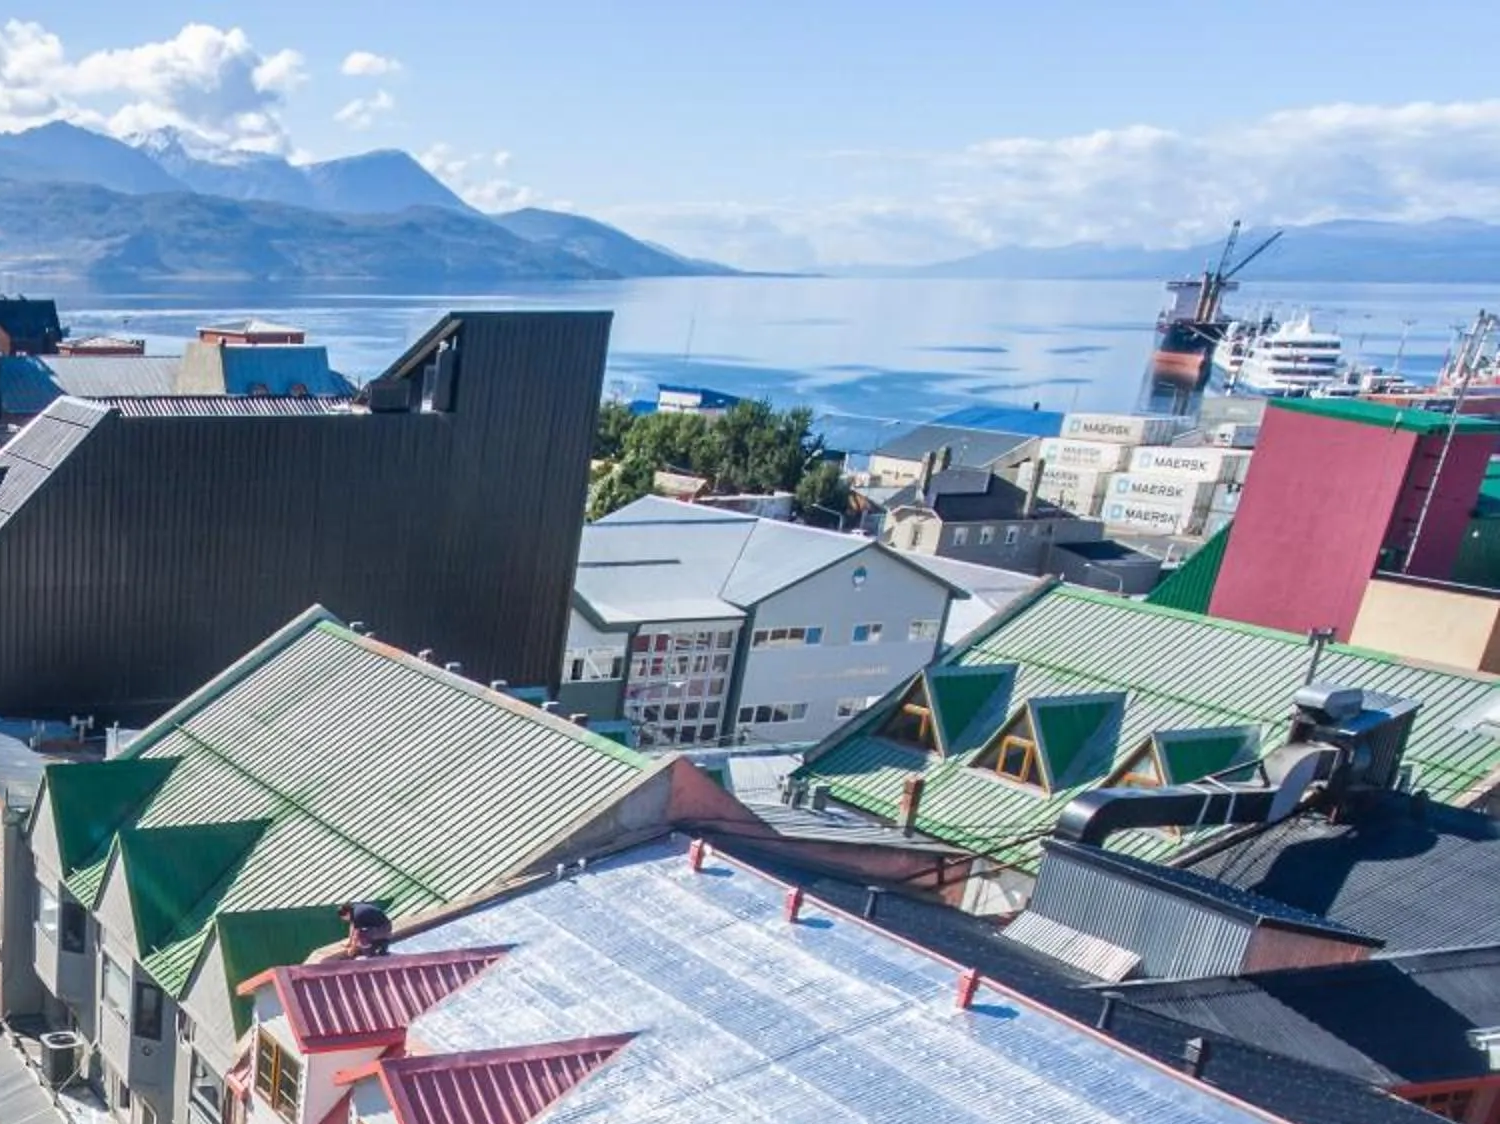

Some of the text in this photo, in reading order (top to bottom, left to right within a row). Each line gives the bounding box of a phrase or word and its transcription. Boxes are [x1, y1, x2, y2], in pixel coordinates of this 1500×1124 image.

[1083, 422, 1131, 435] MAERSK
[1154, 457, 1208, 471] MAERSK
[1131, 483, 1185, 497] MAERSK
[1124, 509, 1177, 524] MAERSK
